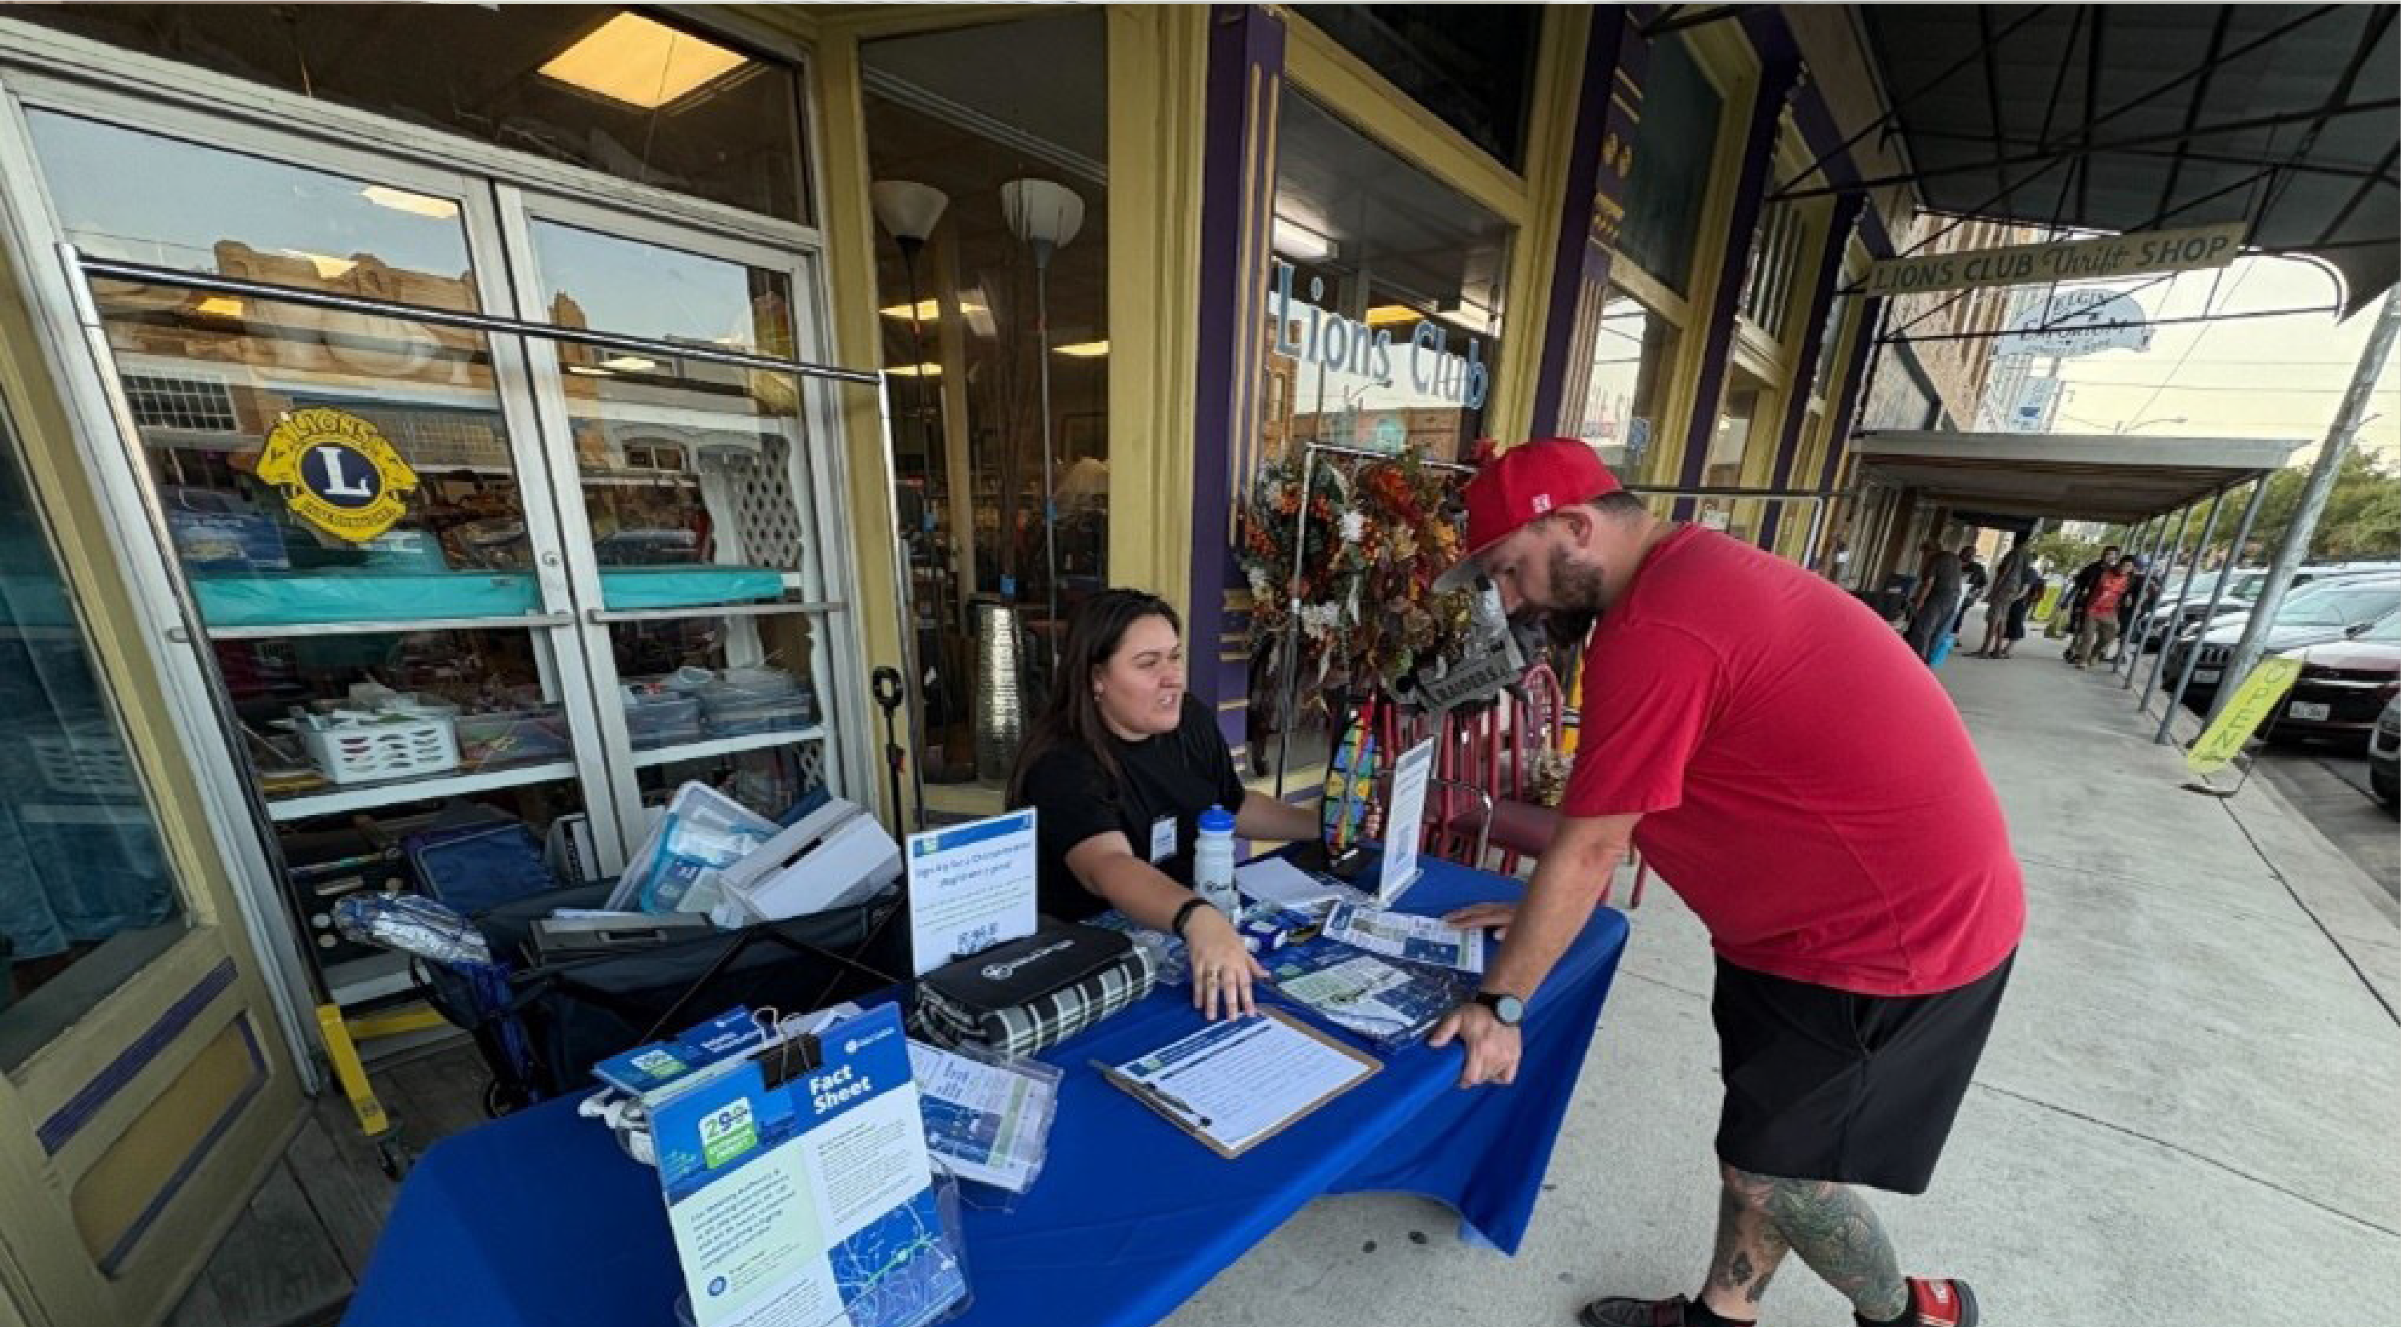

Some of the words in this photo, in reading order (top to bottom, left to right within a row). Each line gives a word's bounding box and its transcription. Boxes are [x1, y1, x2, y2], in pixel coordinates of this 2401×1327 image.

[1873, 260, 1955, 291] LIONS
[1963, 253, 2034, 281] CLUB
[2043, 244, 2130, 274] Thrift
[2136, 236, 2230, 266] SHOP
[1271, 257, 1392, 382] Lions
[1411, 319, 1489, 410] Club
[295, 412, 372, 443] LIONS
[316, 446, 372, 498] L
[2213, 659, 2289, 749] OPEN
[810, 1064, 853, 1097] Fact
[814, 1076, 872, 1115] Sheet
